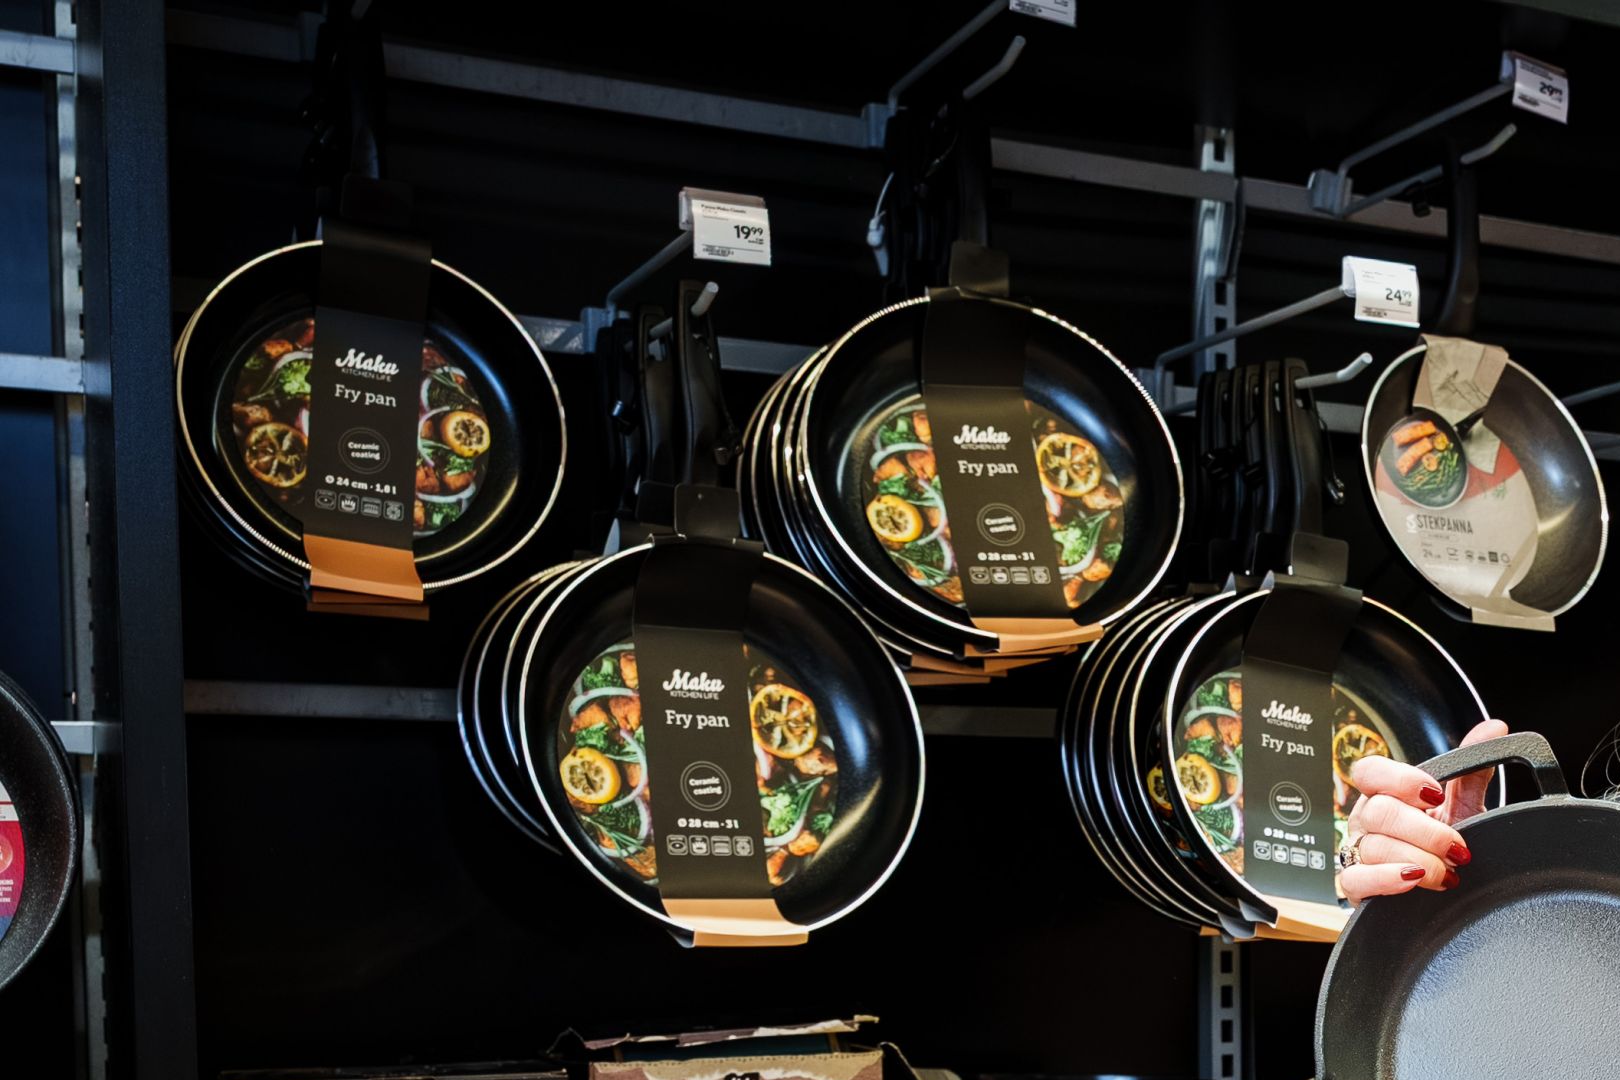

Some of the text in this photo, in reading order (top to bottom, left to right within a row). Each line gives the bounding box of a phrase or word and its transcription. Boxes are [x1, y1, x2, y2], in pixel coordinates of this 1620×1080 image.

[335, 348, 400, 376] Maku
[341, 367, 392, 382] KITCHEN LIFE
[334, 383, 397, 407] Fry pan
[953, 424, 1011, 444] Maku
[347, 441, 381, 460] Ceramic coating
[957, 460, 1019, 477] Fry pan
[336, 476, 349, 487] 24
[351, 480, 368, 490] cm
[1416, 514, 1474, 535] STEKPANNA
[987, 552, 1001, 561] 28
[1001, 552, 1017, 561] cm
[1021, 551, 1029, 561] 3
[662, 669, 725, 692] Maku
[665, 709, 730, 729] Fry pan
[1261, 700, 1313, 725] Maku
[1261, 733, 1315, 756] Fry pan
[689, 776, 722, 795] Ceramic coating
[688, 818, 701, 828] 28
[702, 819, 719, 829] cm
[725, 819, 733, 829] 3
[1284, 832, 1299, 842] cm
